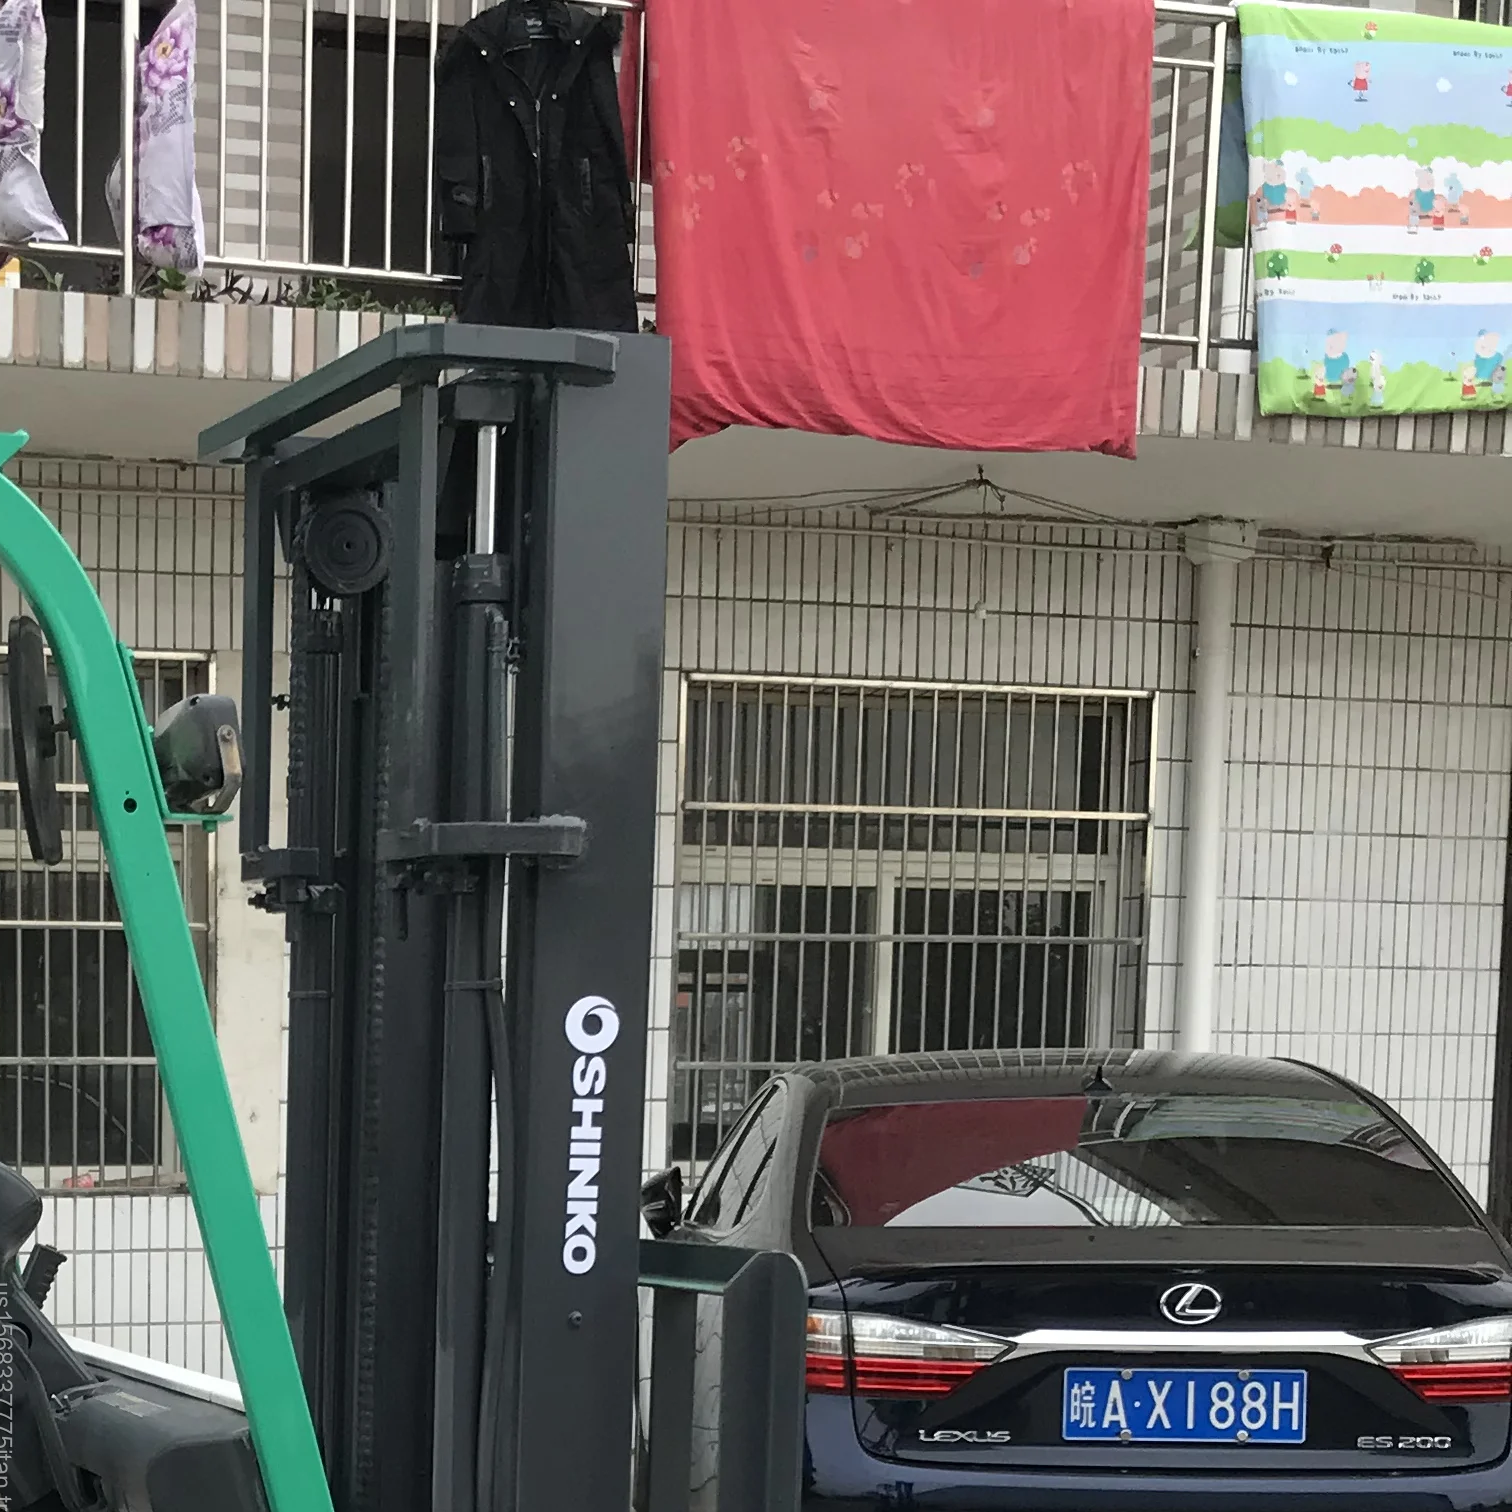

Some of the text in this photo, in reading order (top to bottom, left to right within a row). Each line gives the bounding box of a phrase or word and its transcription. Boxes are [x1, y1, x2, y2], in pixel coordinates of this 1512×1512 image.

[562, 1055, 607, 1275] SHINKO
[918, 1429, 1011, 1443] LEXUS
[1357, 1436, 1451, 1448] ES 200
